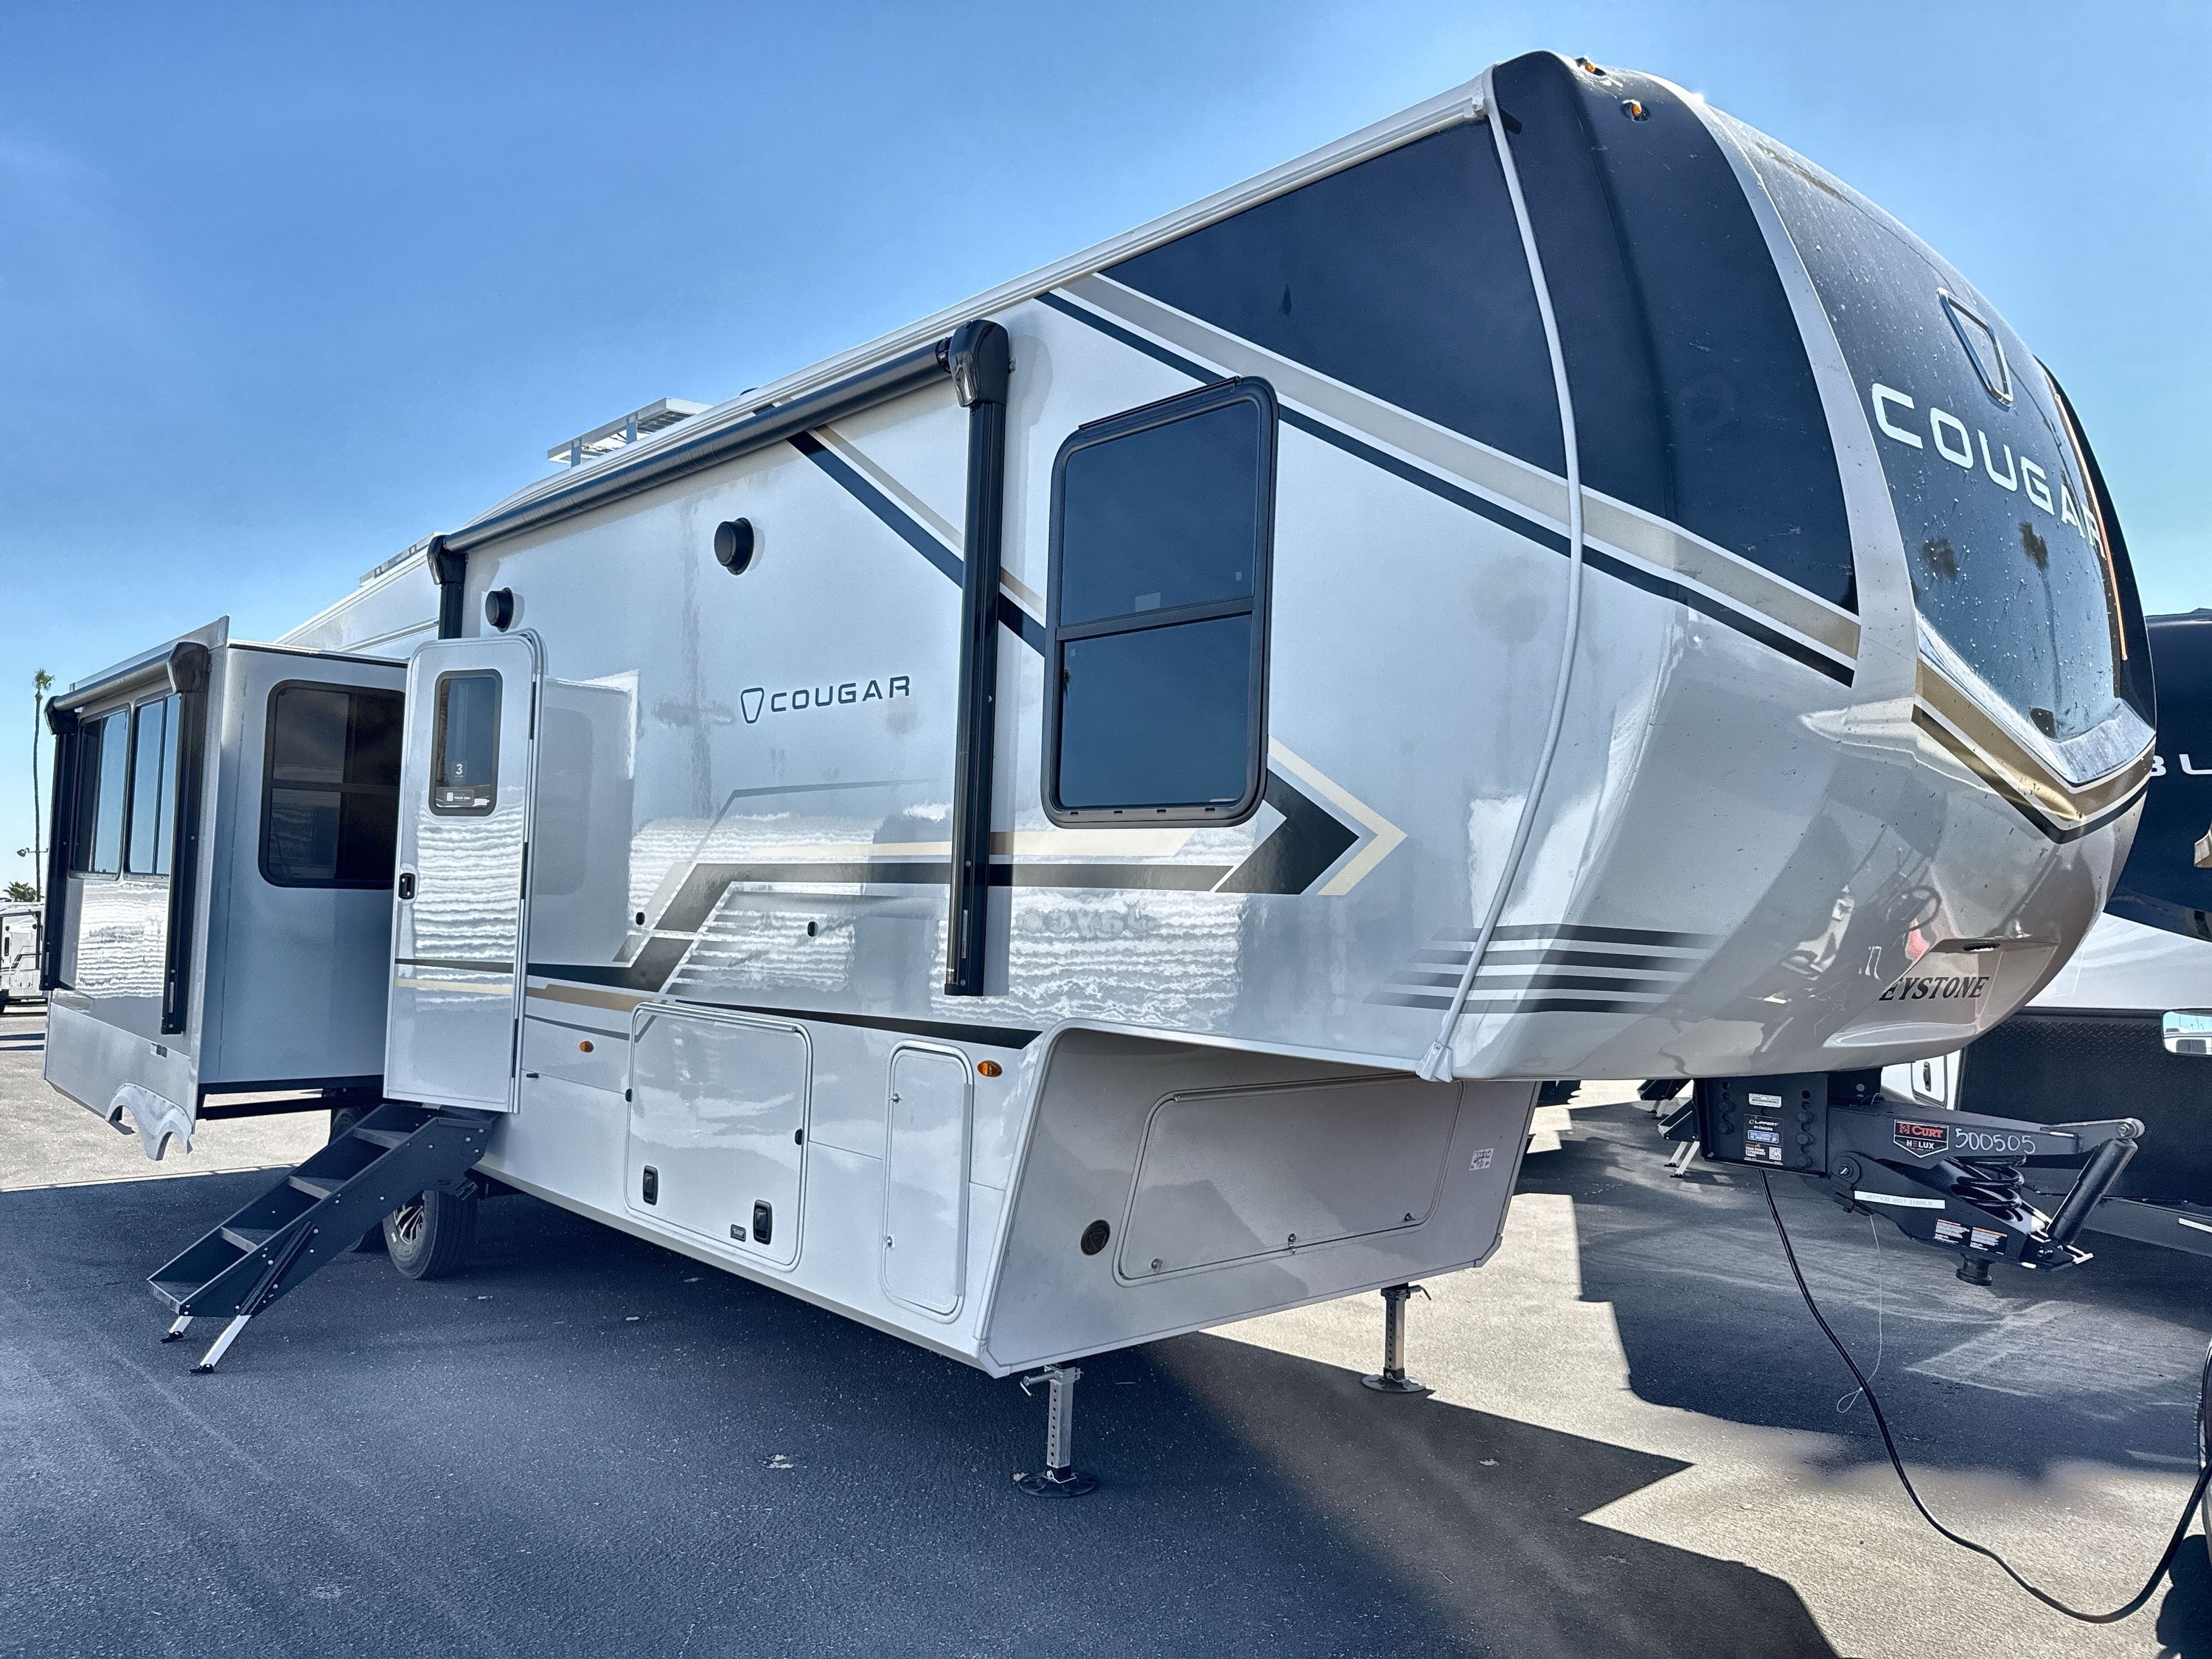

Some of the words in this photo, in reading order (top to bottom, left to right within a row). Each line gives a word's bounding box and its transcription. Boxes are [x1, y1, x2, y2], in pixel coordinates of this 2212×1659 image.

[1871, 383, 2106, 560] COUGAR
[771, 675, 910, 712] COUGAR
[455, 763, 463, 775] 3
[1911, 1125, 1944, 1138] CURT
[1955, 1128, 2037, 1155] 500505
[1906, 1139, 1935, 1150] HELUX
